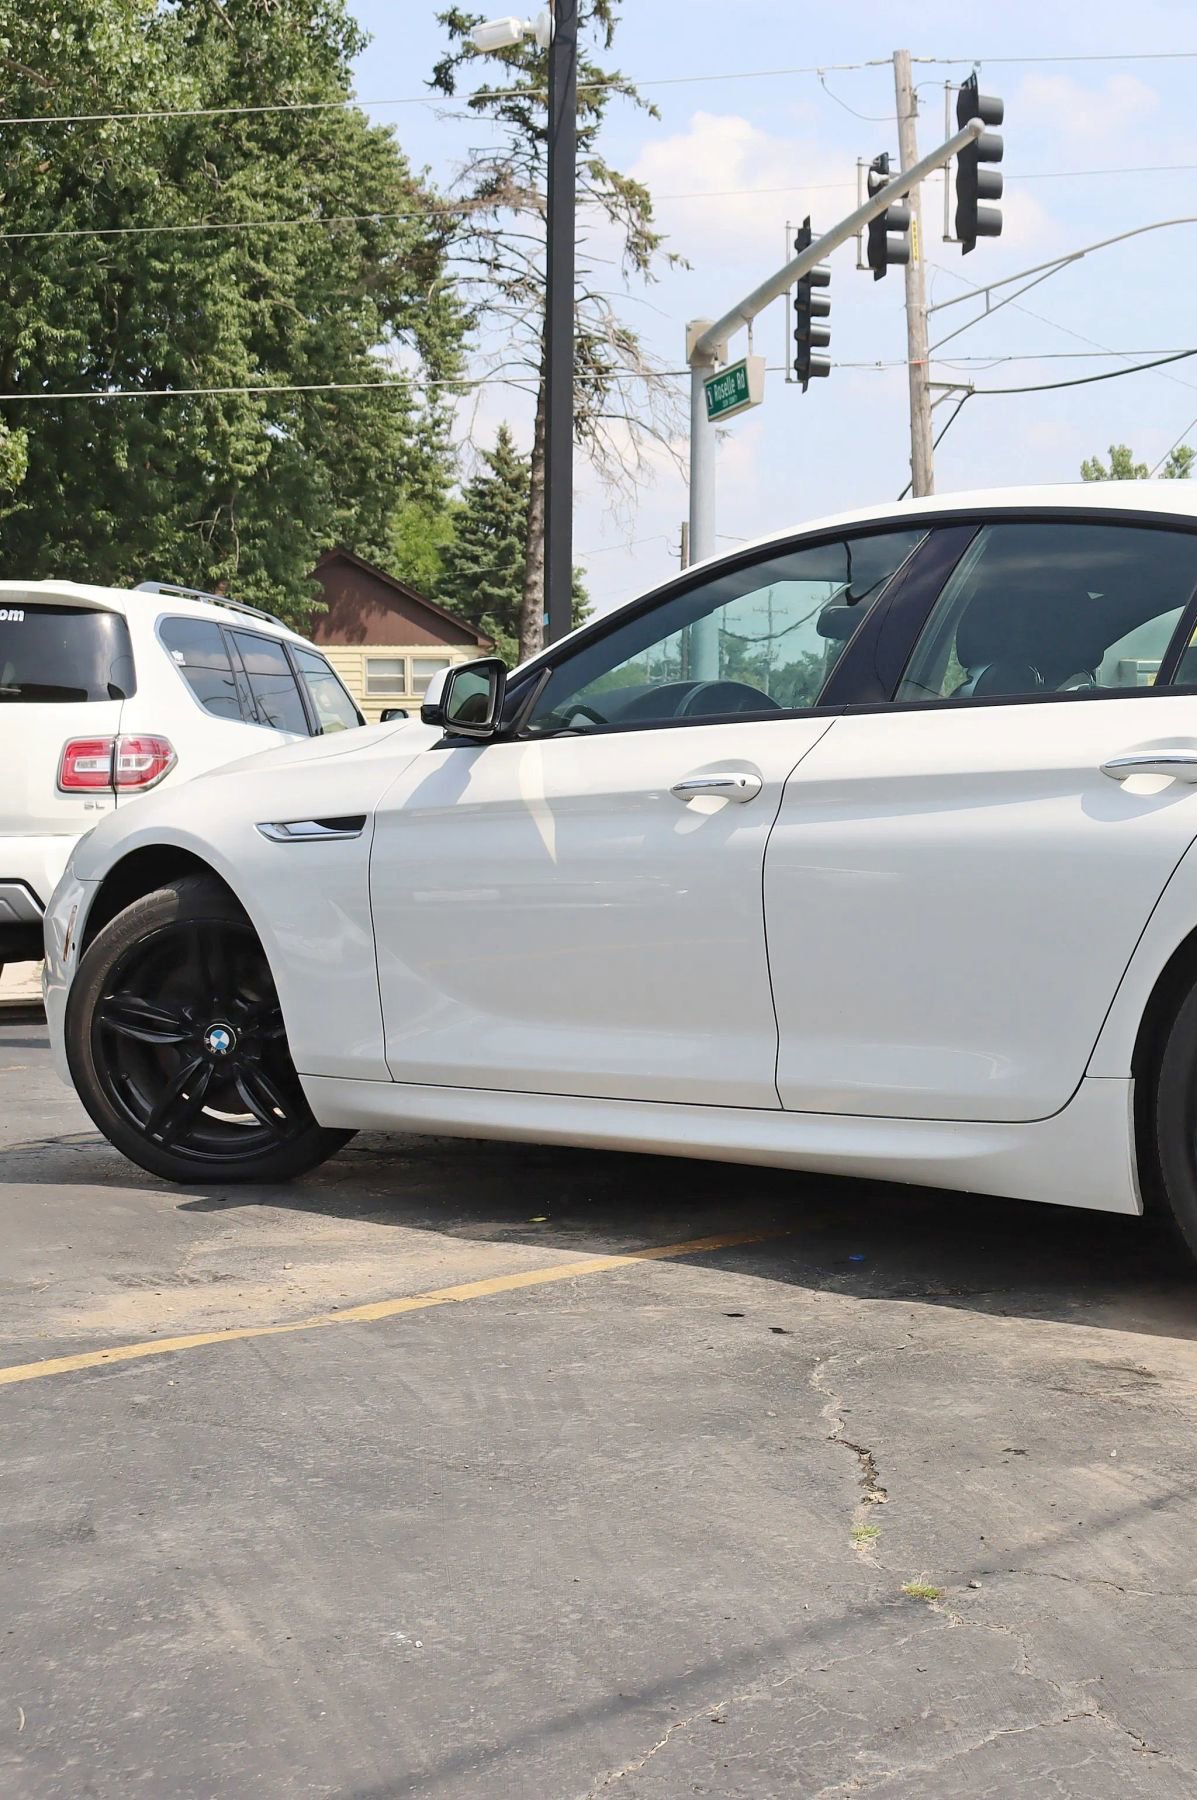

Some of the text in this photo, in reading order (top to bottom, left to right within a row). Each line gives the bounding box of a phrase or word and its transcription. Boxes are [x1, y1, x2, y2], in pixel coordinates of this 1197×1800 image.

[713, 368, 746, 402] Roselle Rd
[84, 801, 105, 811] SL
